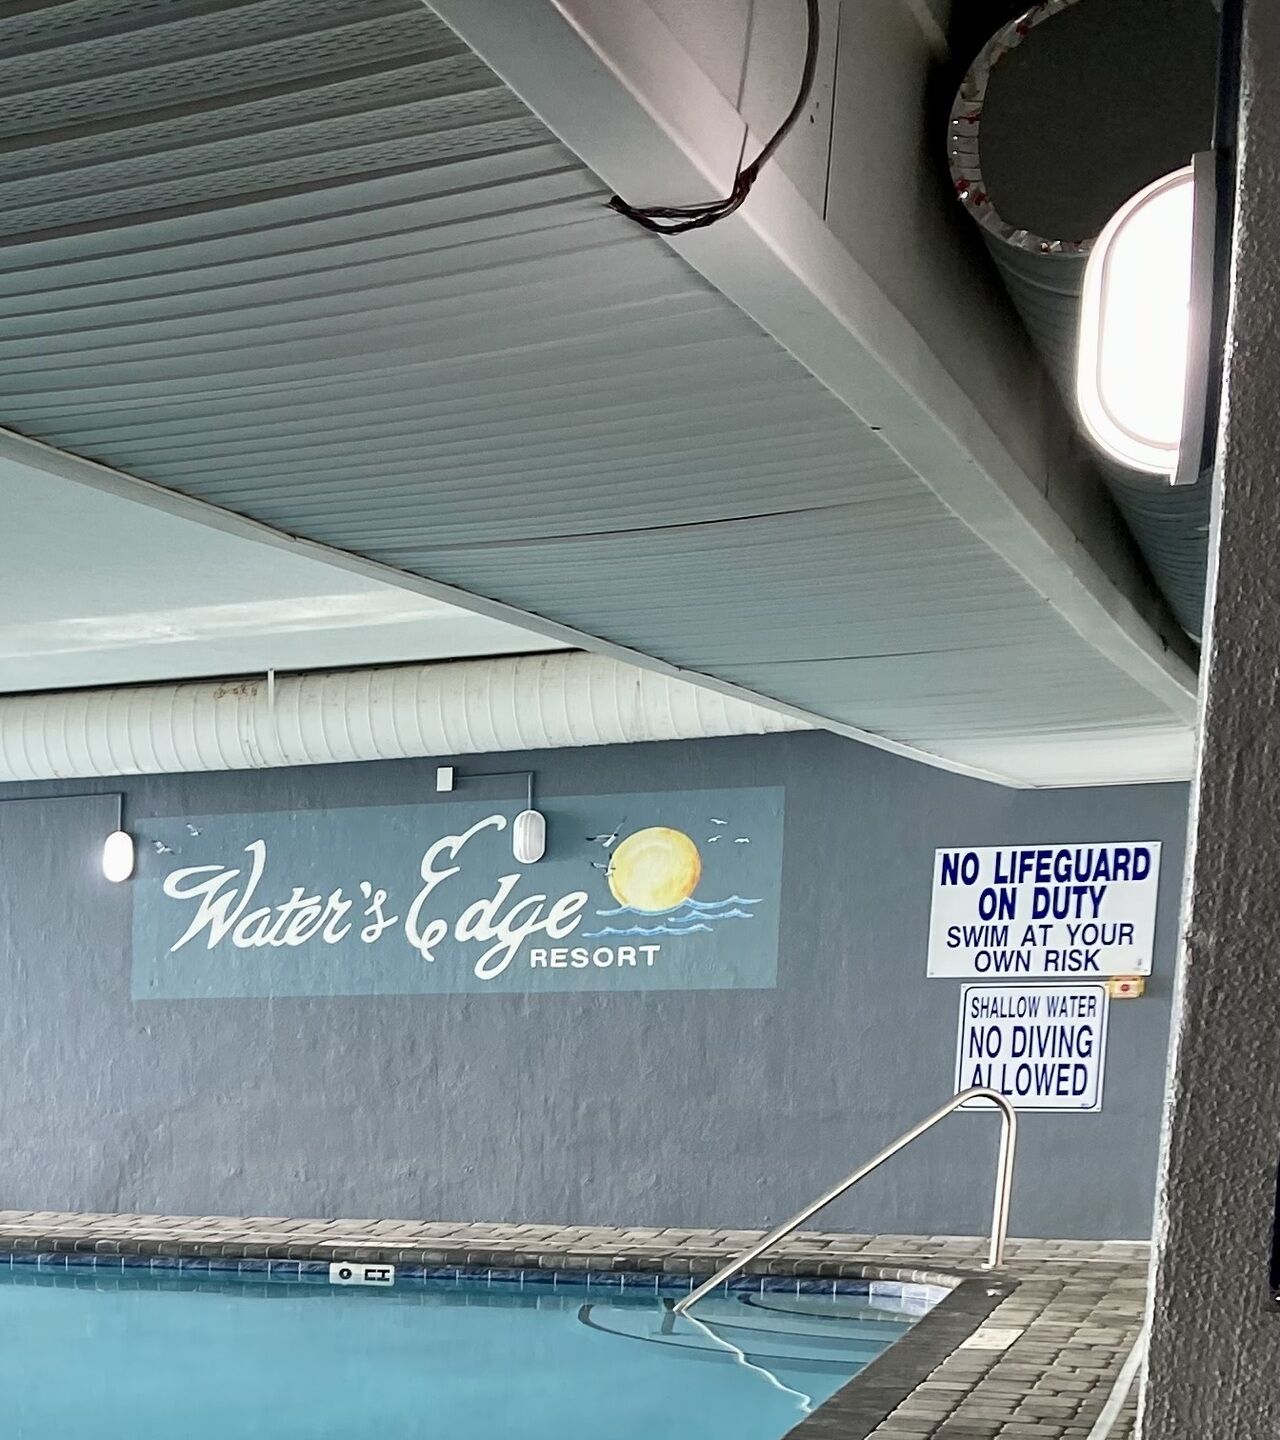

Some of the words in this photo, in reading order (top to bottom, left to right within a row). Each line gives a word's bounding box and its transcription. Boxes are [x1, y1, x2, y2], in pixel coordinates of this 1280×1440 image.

[941, 851, 979, 886] NO
[994, 847, 1151, 884] LIFEGUARD
[163, 839, 397, 952] Water's
[405, 814, 589, 980] Edge
[978, 887, 1017, 920] ON
[1032, 885, 1107, 920] DUTY
[947, 925, 1009, 948] SWIM
[1021, 924, 1053, 947] AT
[1067, 923, 1134, 946] YOUR
[530, 944, 661, 968] RESORT
[974, 950, 1031, 973] OWN
[1044, 949, 1101, 972] RISK
[970, 996, 1040, 1019] SHALLOW
[1047, 995, 1097, 1018] WATER
[969, 1026, 1002, 1058] NO
[1011, 1025, 1094, 1058] DIVING
